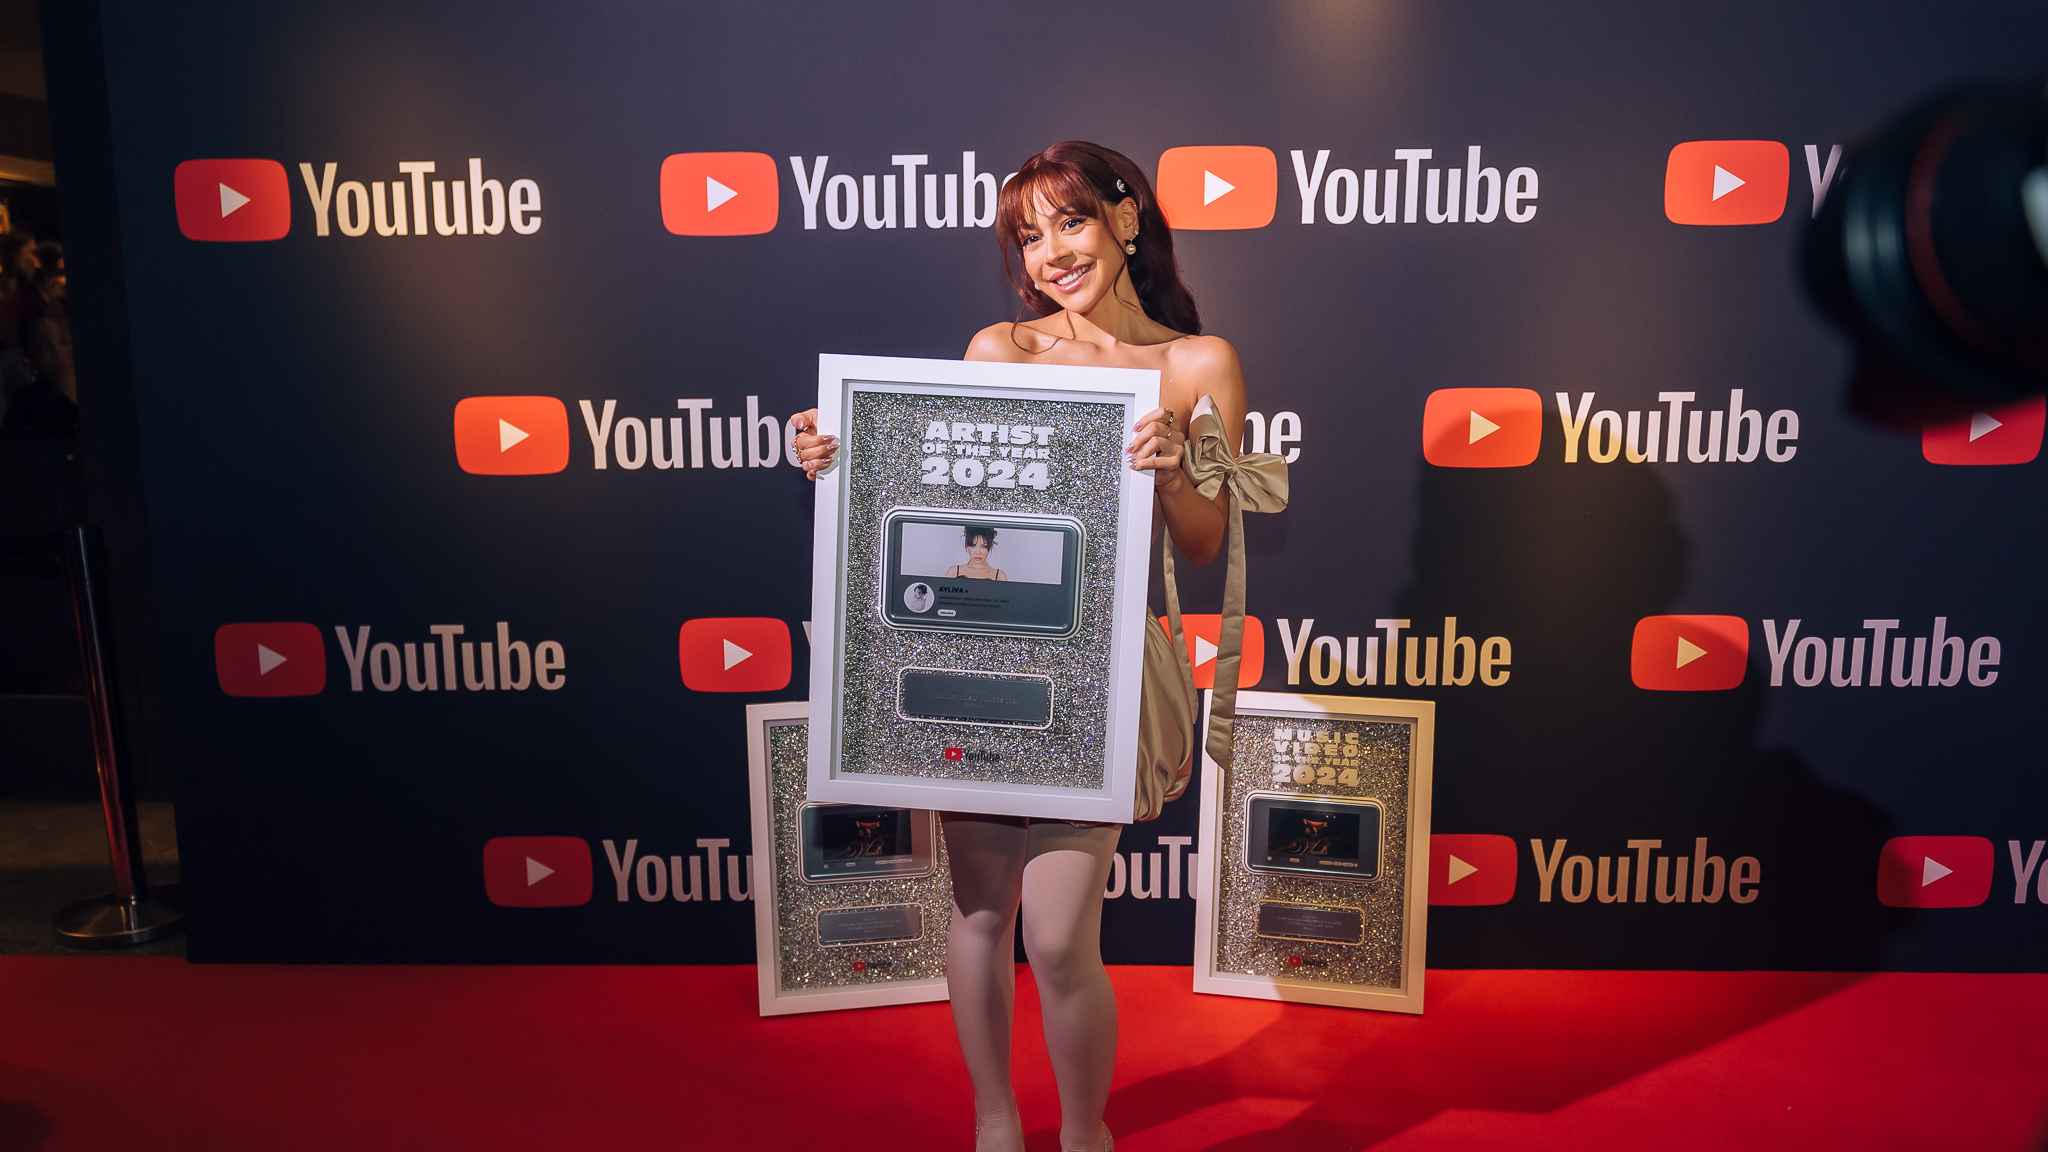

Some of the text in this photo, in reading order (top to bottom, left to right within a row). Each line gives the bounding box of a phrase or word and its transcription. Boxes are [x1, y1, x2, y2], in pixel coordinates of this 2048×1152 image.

[300, 158, 542, 237] YouTube
[789, 151, 1020, 230] YouTub
[1290, 145, 1539, 225] YouTube
[921, 441, 1051, 460] OF THE YEAR
[924, 421, 1054, 446] ARTIST
[1555, 388, 1800, 464] YouTube
[920, 456, 1051, 491] 2024
[335, 622, 566, 692] YouTube
[1276, 617, 1512, 687] YouTube
[1762, 617, 2001, 688] YouTube
[1272, 763, 1361, 787] 2024
[1273, 740, 1359, 758] VIDEO
[1530, 838, 1761, 903] YouTube
